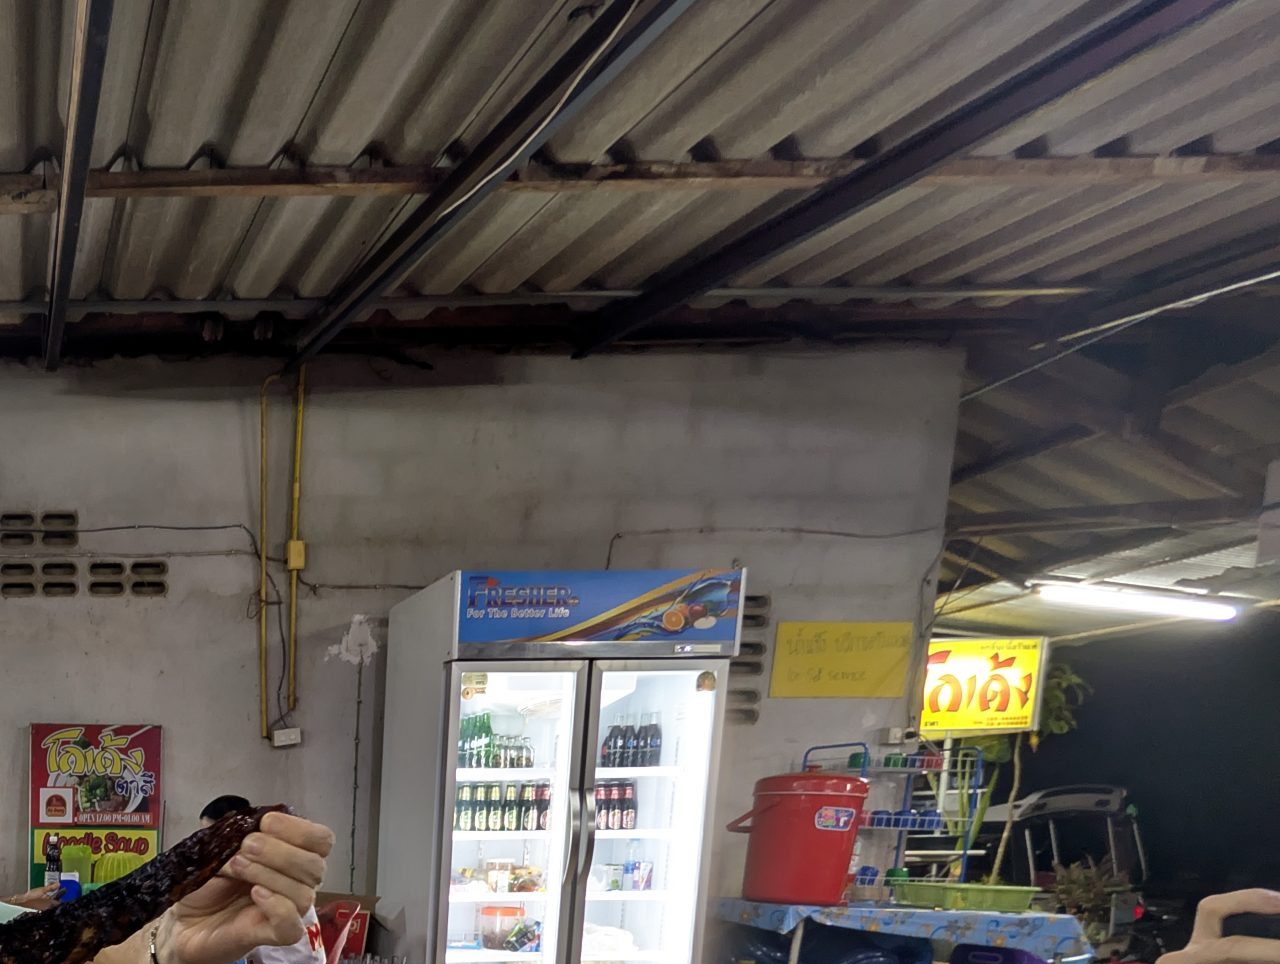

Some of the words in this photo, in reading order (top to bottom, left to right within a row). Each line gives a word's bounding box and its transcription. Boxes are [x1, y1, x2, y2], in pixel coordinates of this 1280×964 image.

[468, 576, 572, 607] FRESHER
[467, 609, 485, 618] For
[488, 609, 508, 618] The
[511, 609, 545, 618] Better
[548, 607, 570, 618] Life
